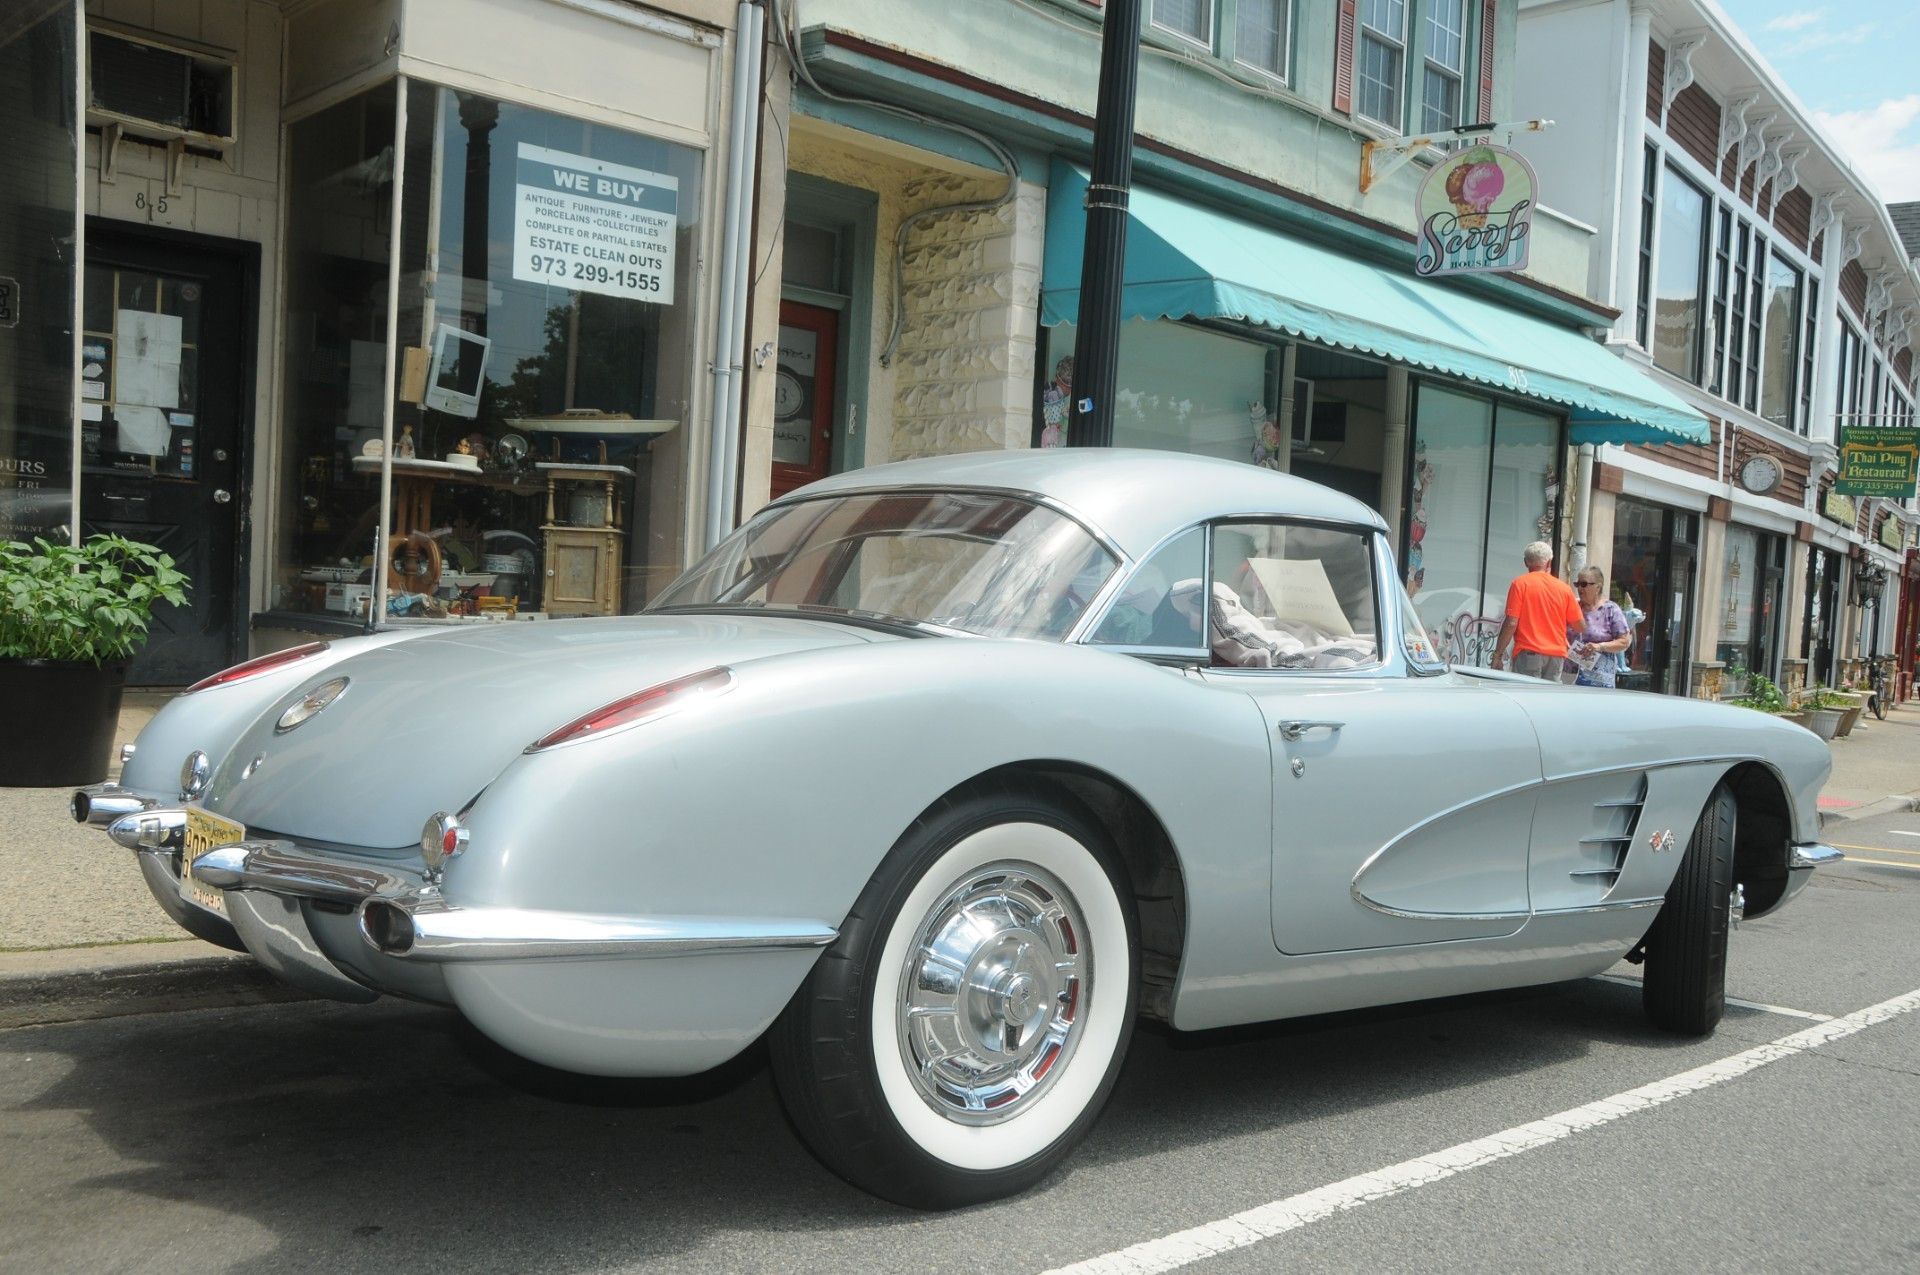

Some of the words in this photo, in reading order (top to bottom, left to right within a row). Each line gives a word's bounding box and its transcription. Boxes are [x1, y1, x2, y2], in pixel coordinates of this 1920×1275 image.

[553, 169, 590, 192] WE
[597, 178, 644, 202] BUY
[525, 193, 565, 208] ANTIQUE
[572, 202, 622, 219] FURNITURE
[630, 213, 668, 228] JEWELRY
[535, 207, 590, 224] PORCELAINS
[596, 218, 659, 237] COLLECTIBLES
[525, 219, 574, 236] COMPLETE
[577, 229, 590, 239] OR
[591, 232, 628, 246] PARTIAL
[630, 240, 668, 254] ESTATES
[530, 235, 579, 255] ESTATE
[583, 246, 625, 263] CLEAN
[629, 254, 662, 270] OUTS
[530, 254, 567, 277] 973
[573, 262, 660, 292] 299-1555
[1508, 365, 1527, 388] 813
[1848, 465, 1907, 478] Restaurant
[1850, 451, 1876, 464] Thai
[1880, 452, 1907, 467] Ping
[18, 480, 40, 489] FRI
[1847, 481, 1863, 489] 973
[1865, 482, 1880, 490] 335
